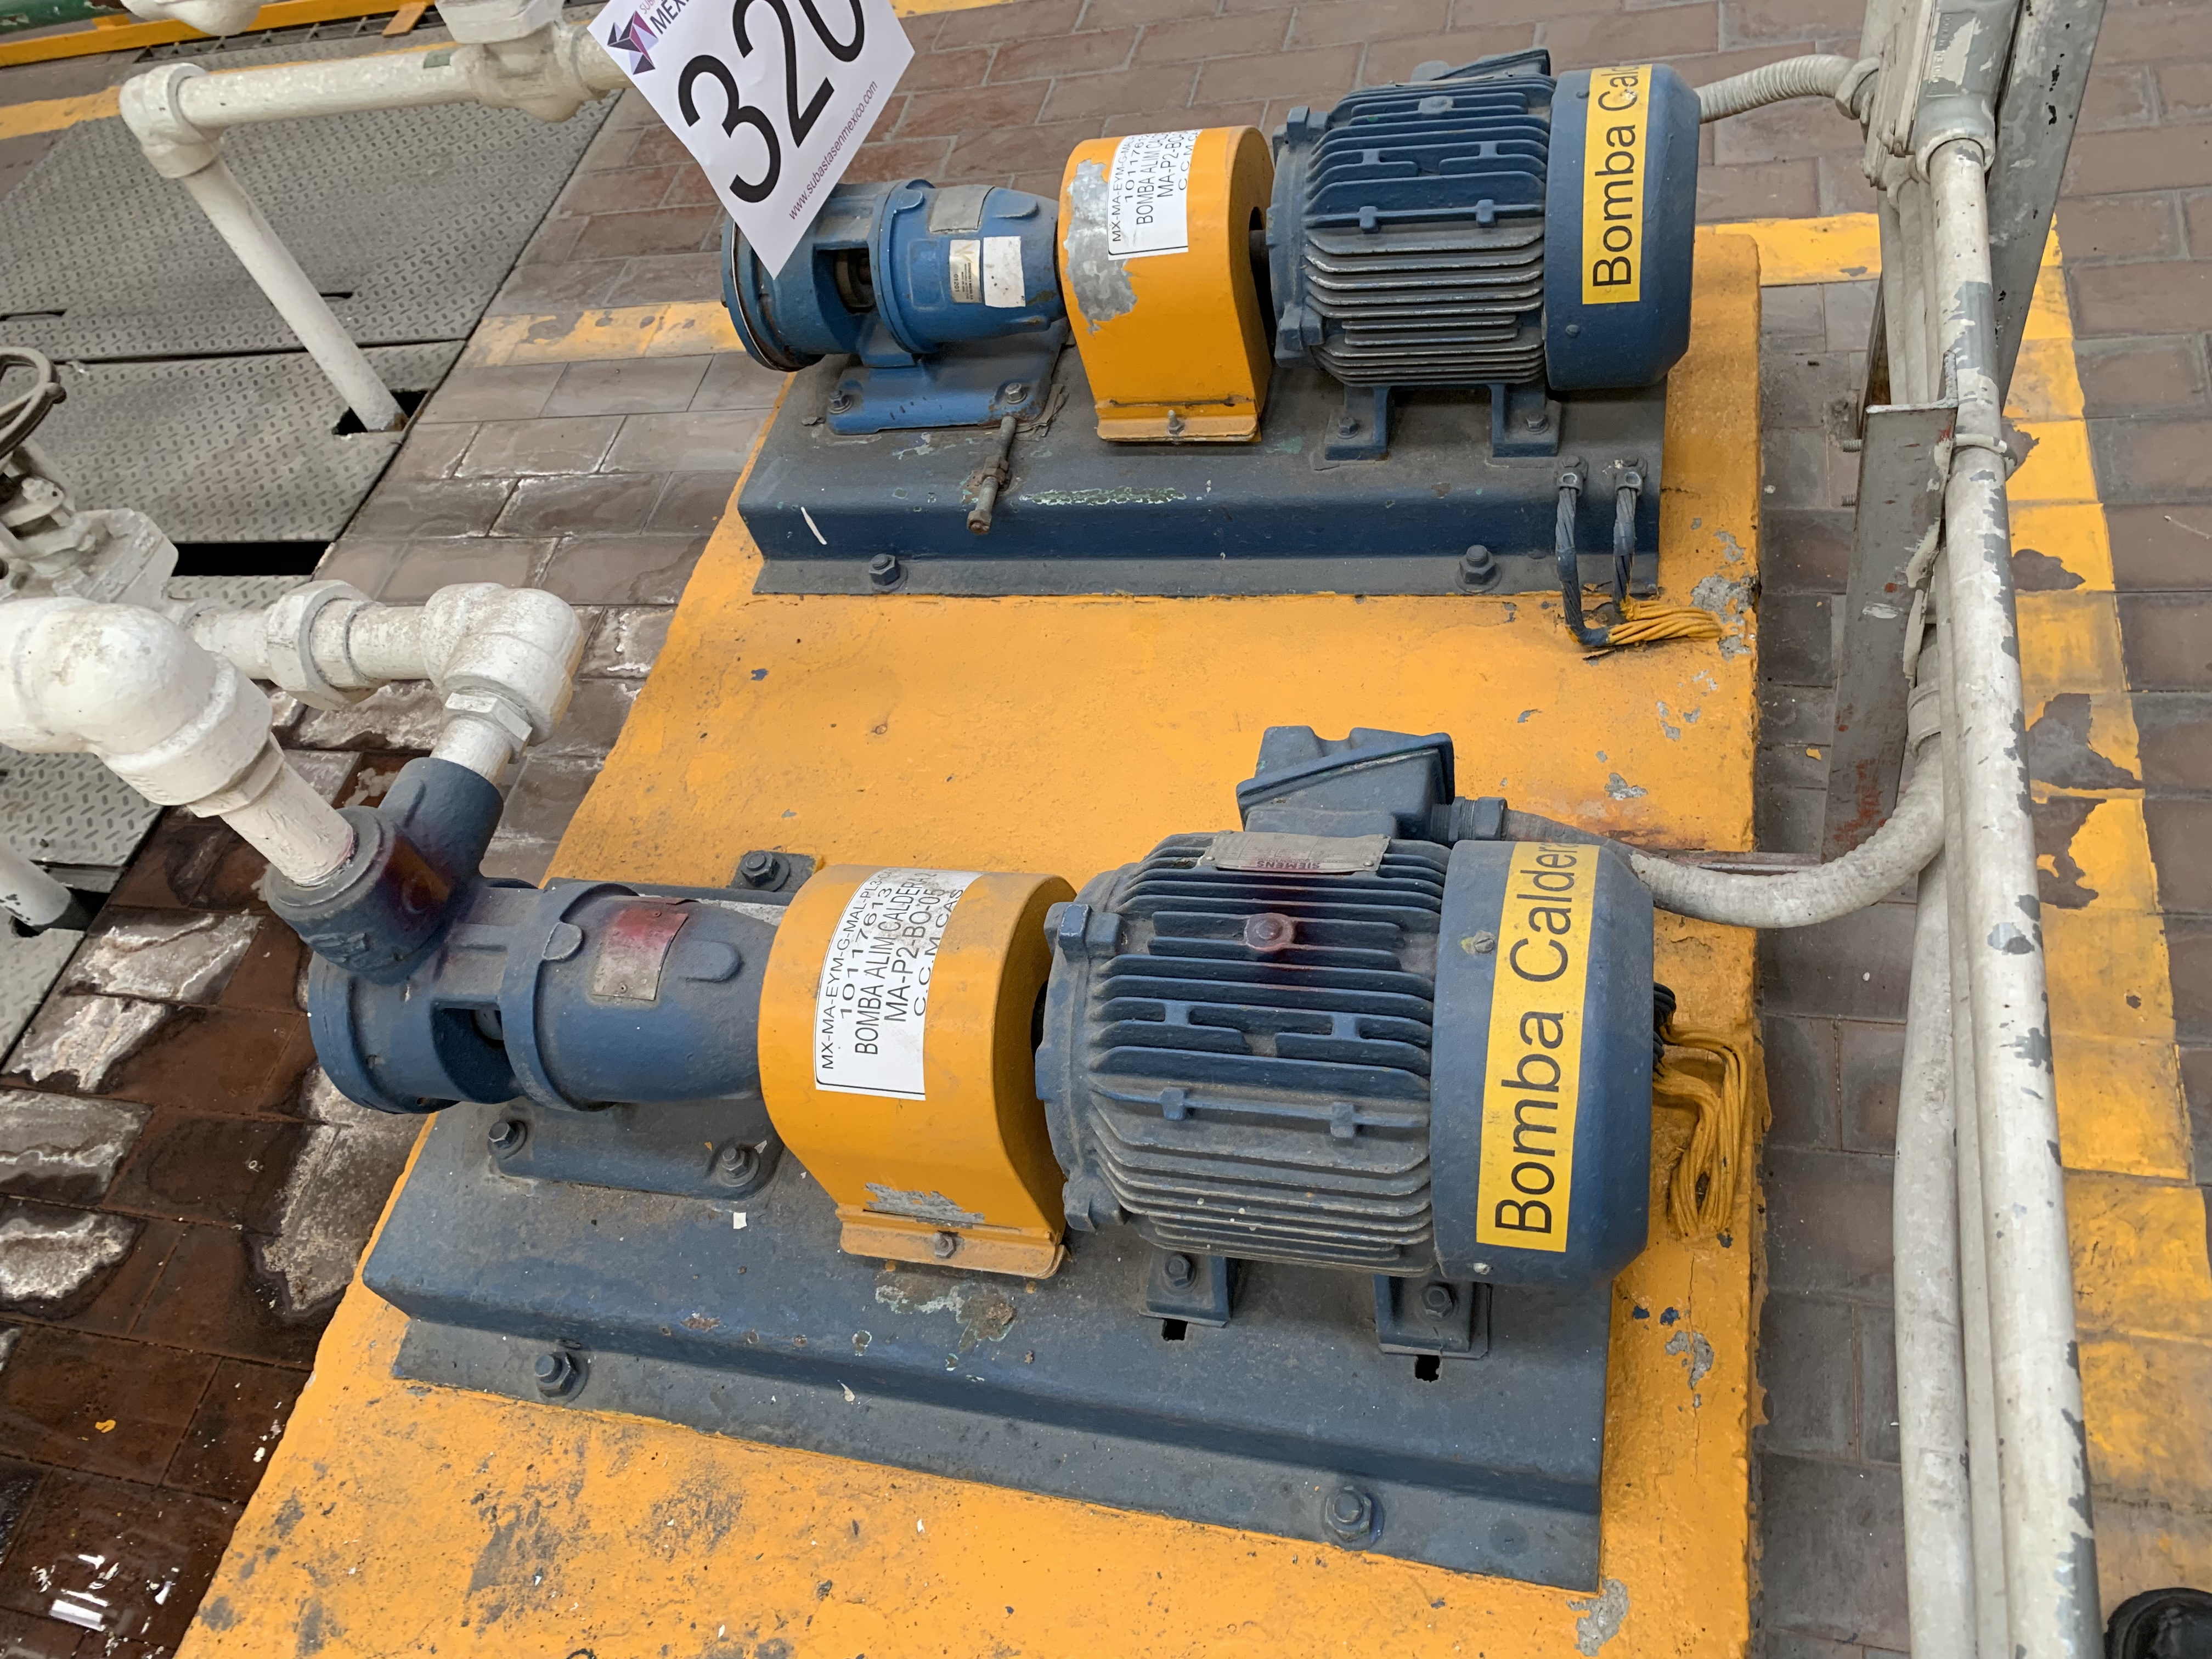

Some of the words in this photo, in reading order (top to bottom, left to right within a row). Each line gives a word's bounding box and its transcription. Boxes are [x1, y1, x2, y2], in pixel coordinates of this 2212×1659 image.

[640, 0, 655, 14] SUB
[650, 0, 689, 34] MEX
[1598, 66, 1639, 111] Cal
[789, 81, 878, 220] www.subastasenmexico.com
[1140, 150, 1160, 174] ALIM
[1136, 176, 1155, 224] BOMBA
[1592, 124, 1636, 287] Bomba
[1256, 860, 1321, 870] SIEMENS
[935, 889, 963, 928] CAS
[840, 888, 892, 1019] 10117613
[864, 936, 896, 979] ALIM
[855, 985, 884, 1054] BOMBA
[1495, 1011, 1564, 1235] Bomba
